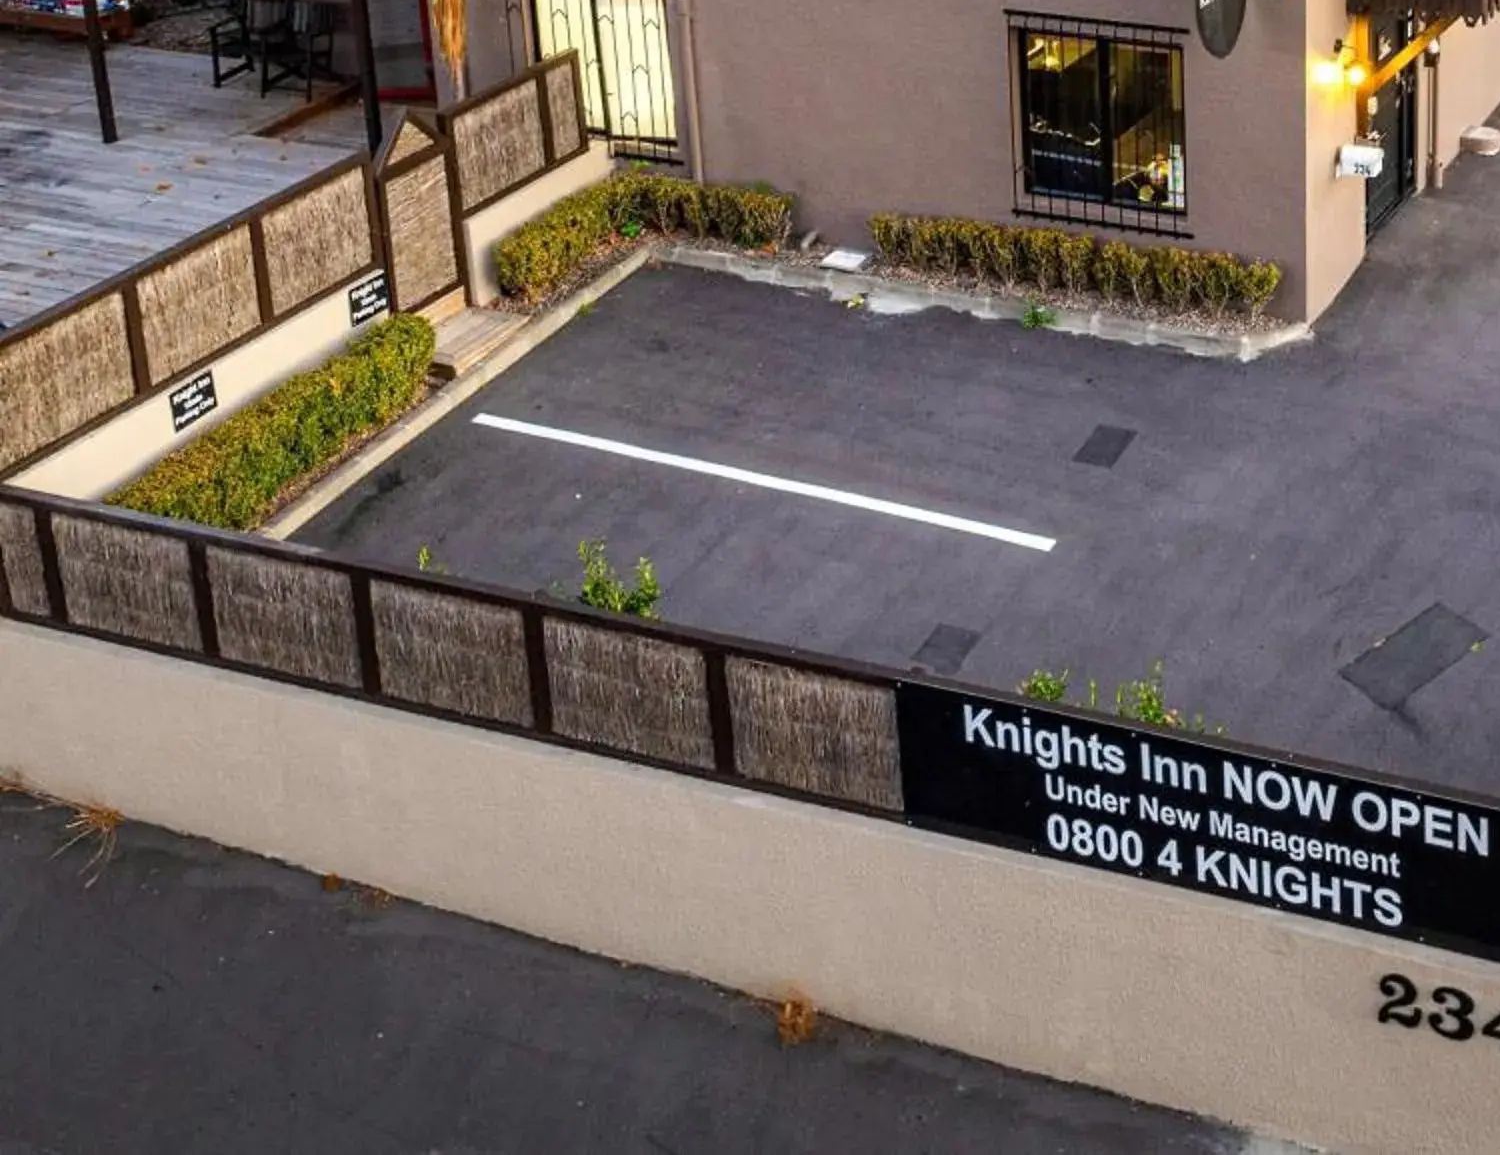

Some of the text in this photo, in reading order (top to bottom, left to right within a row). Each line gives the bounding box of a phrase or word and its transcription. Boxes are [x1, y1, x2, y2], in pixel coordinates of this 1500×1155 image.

[963, 704, 1489, 856] Knights Inn NOW OPEN
[1045, 773, 1401, 878] Under New Management
[1047, 813, 1403, 930] 0800 4 KNIGHTS
